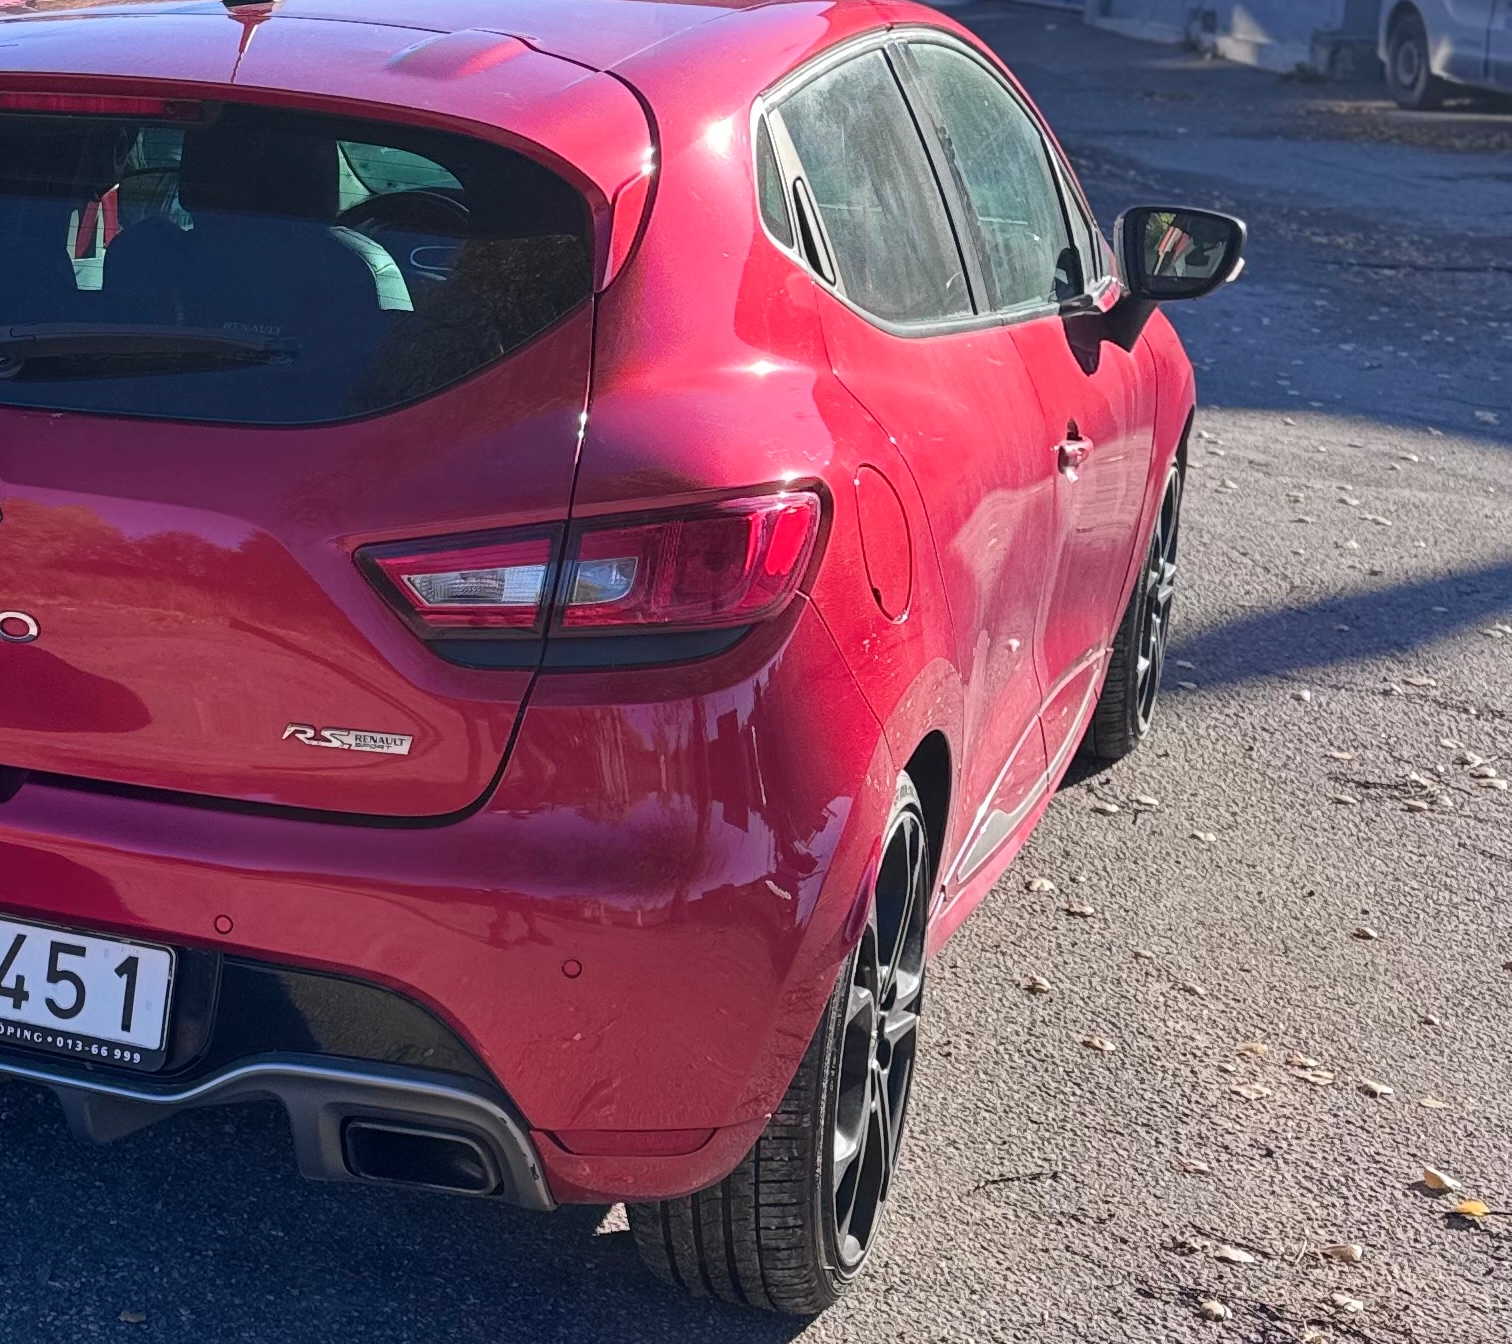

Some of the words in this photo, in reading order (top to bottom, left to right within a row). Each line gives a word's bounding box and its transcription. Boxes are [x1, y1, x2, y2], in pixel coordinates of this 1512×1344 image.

[354, 733, 407, 747] RENAULT
[56, 1037, 108, 1057] 013-66
[113, 1048, 141, 1064] 999
